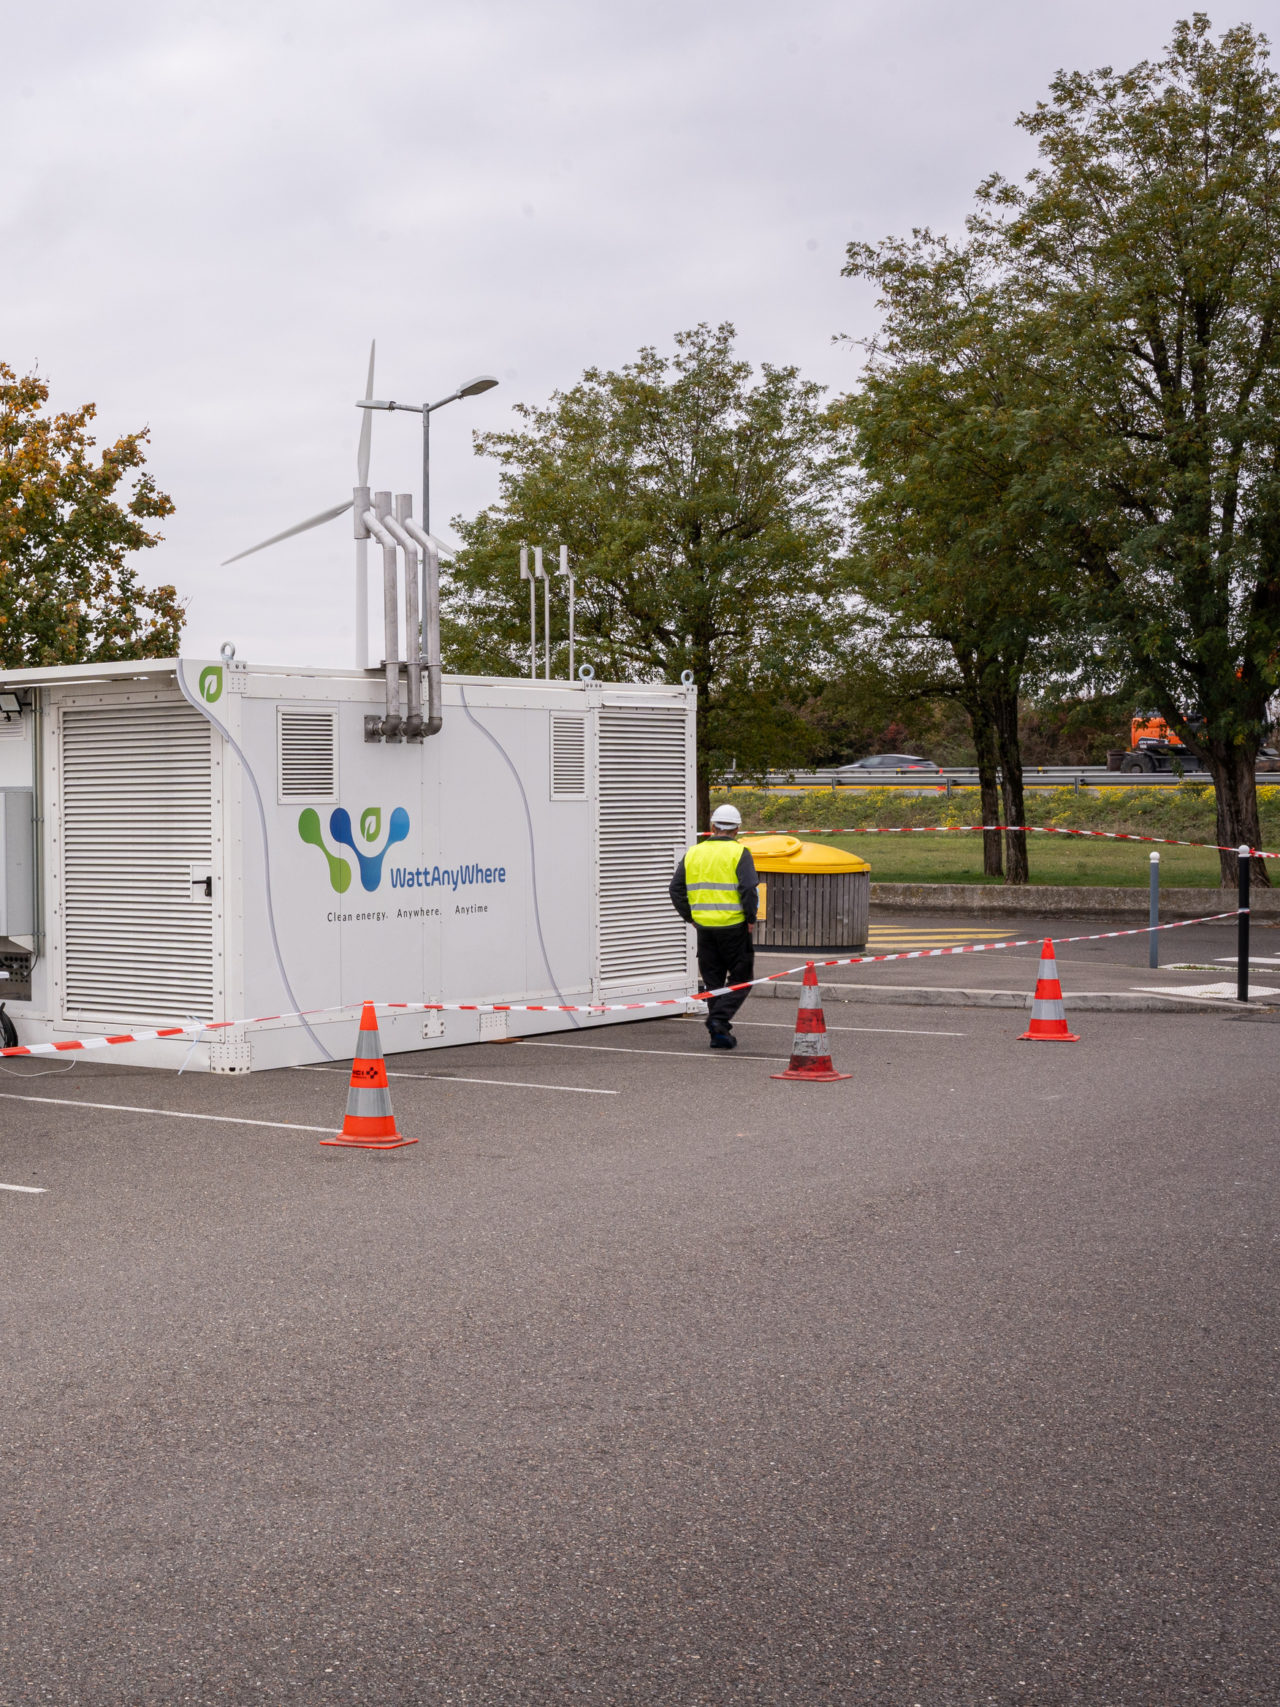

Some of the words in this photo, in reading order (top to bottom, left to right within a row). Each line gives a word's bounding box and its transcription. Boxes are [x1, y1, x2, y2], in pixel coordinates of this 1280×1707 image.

[390, 863, 506, 892] WattAnyWhere
[327, 912, 353, 922] Clean
[455, 904, 488, 915] Anytime
